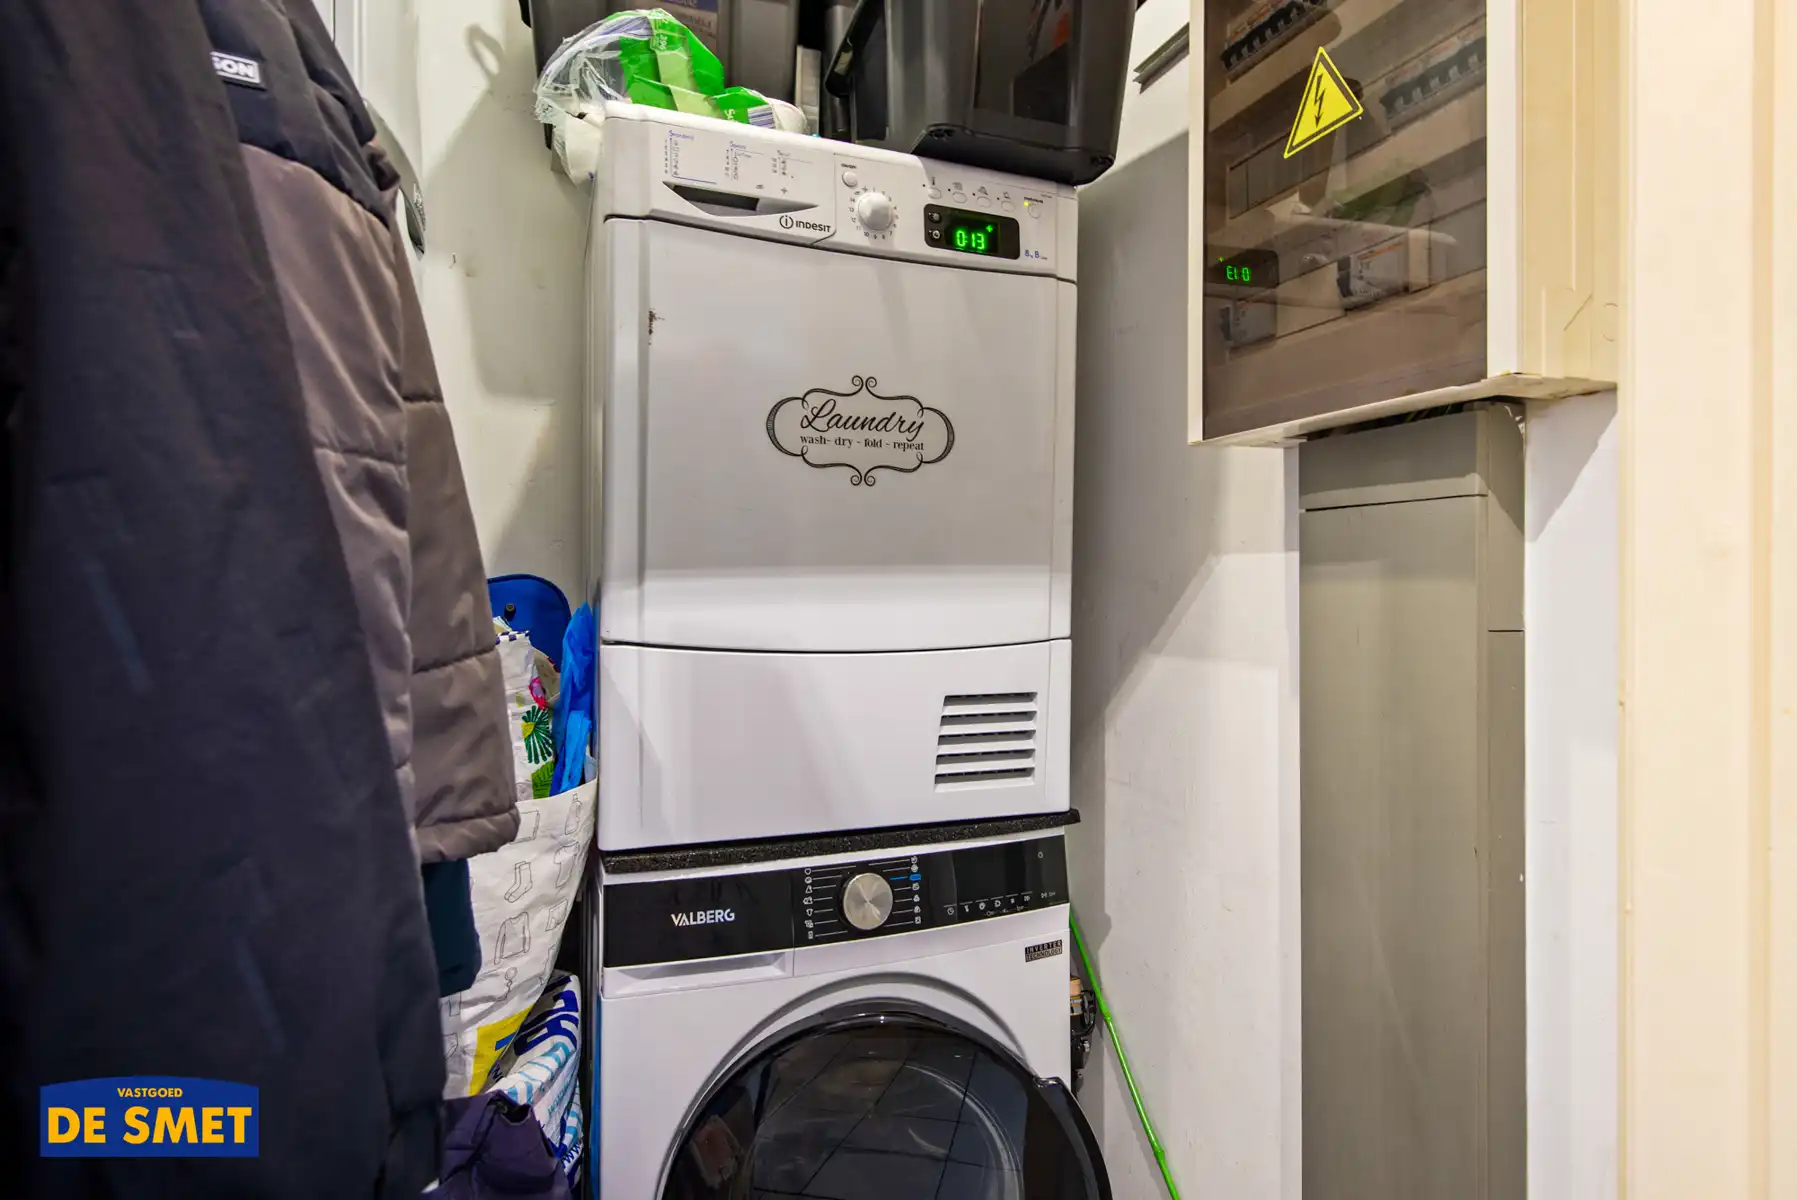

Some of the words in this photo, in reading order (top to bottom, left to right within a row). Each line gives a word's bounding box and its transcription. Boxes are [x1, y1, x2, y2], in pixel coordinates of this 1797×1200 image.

[796, 220, 831, 232] INDESIT
[800, 399, 924, 442] Laundry
[835, 437, 853, 449] dry
[864, 438, 883, 448] fold
[893, 440, 925, 452] repeat
[671, 908, 735, 927] VALBERG
[1026, 940, 1062, 954] INVERTER
